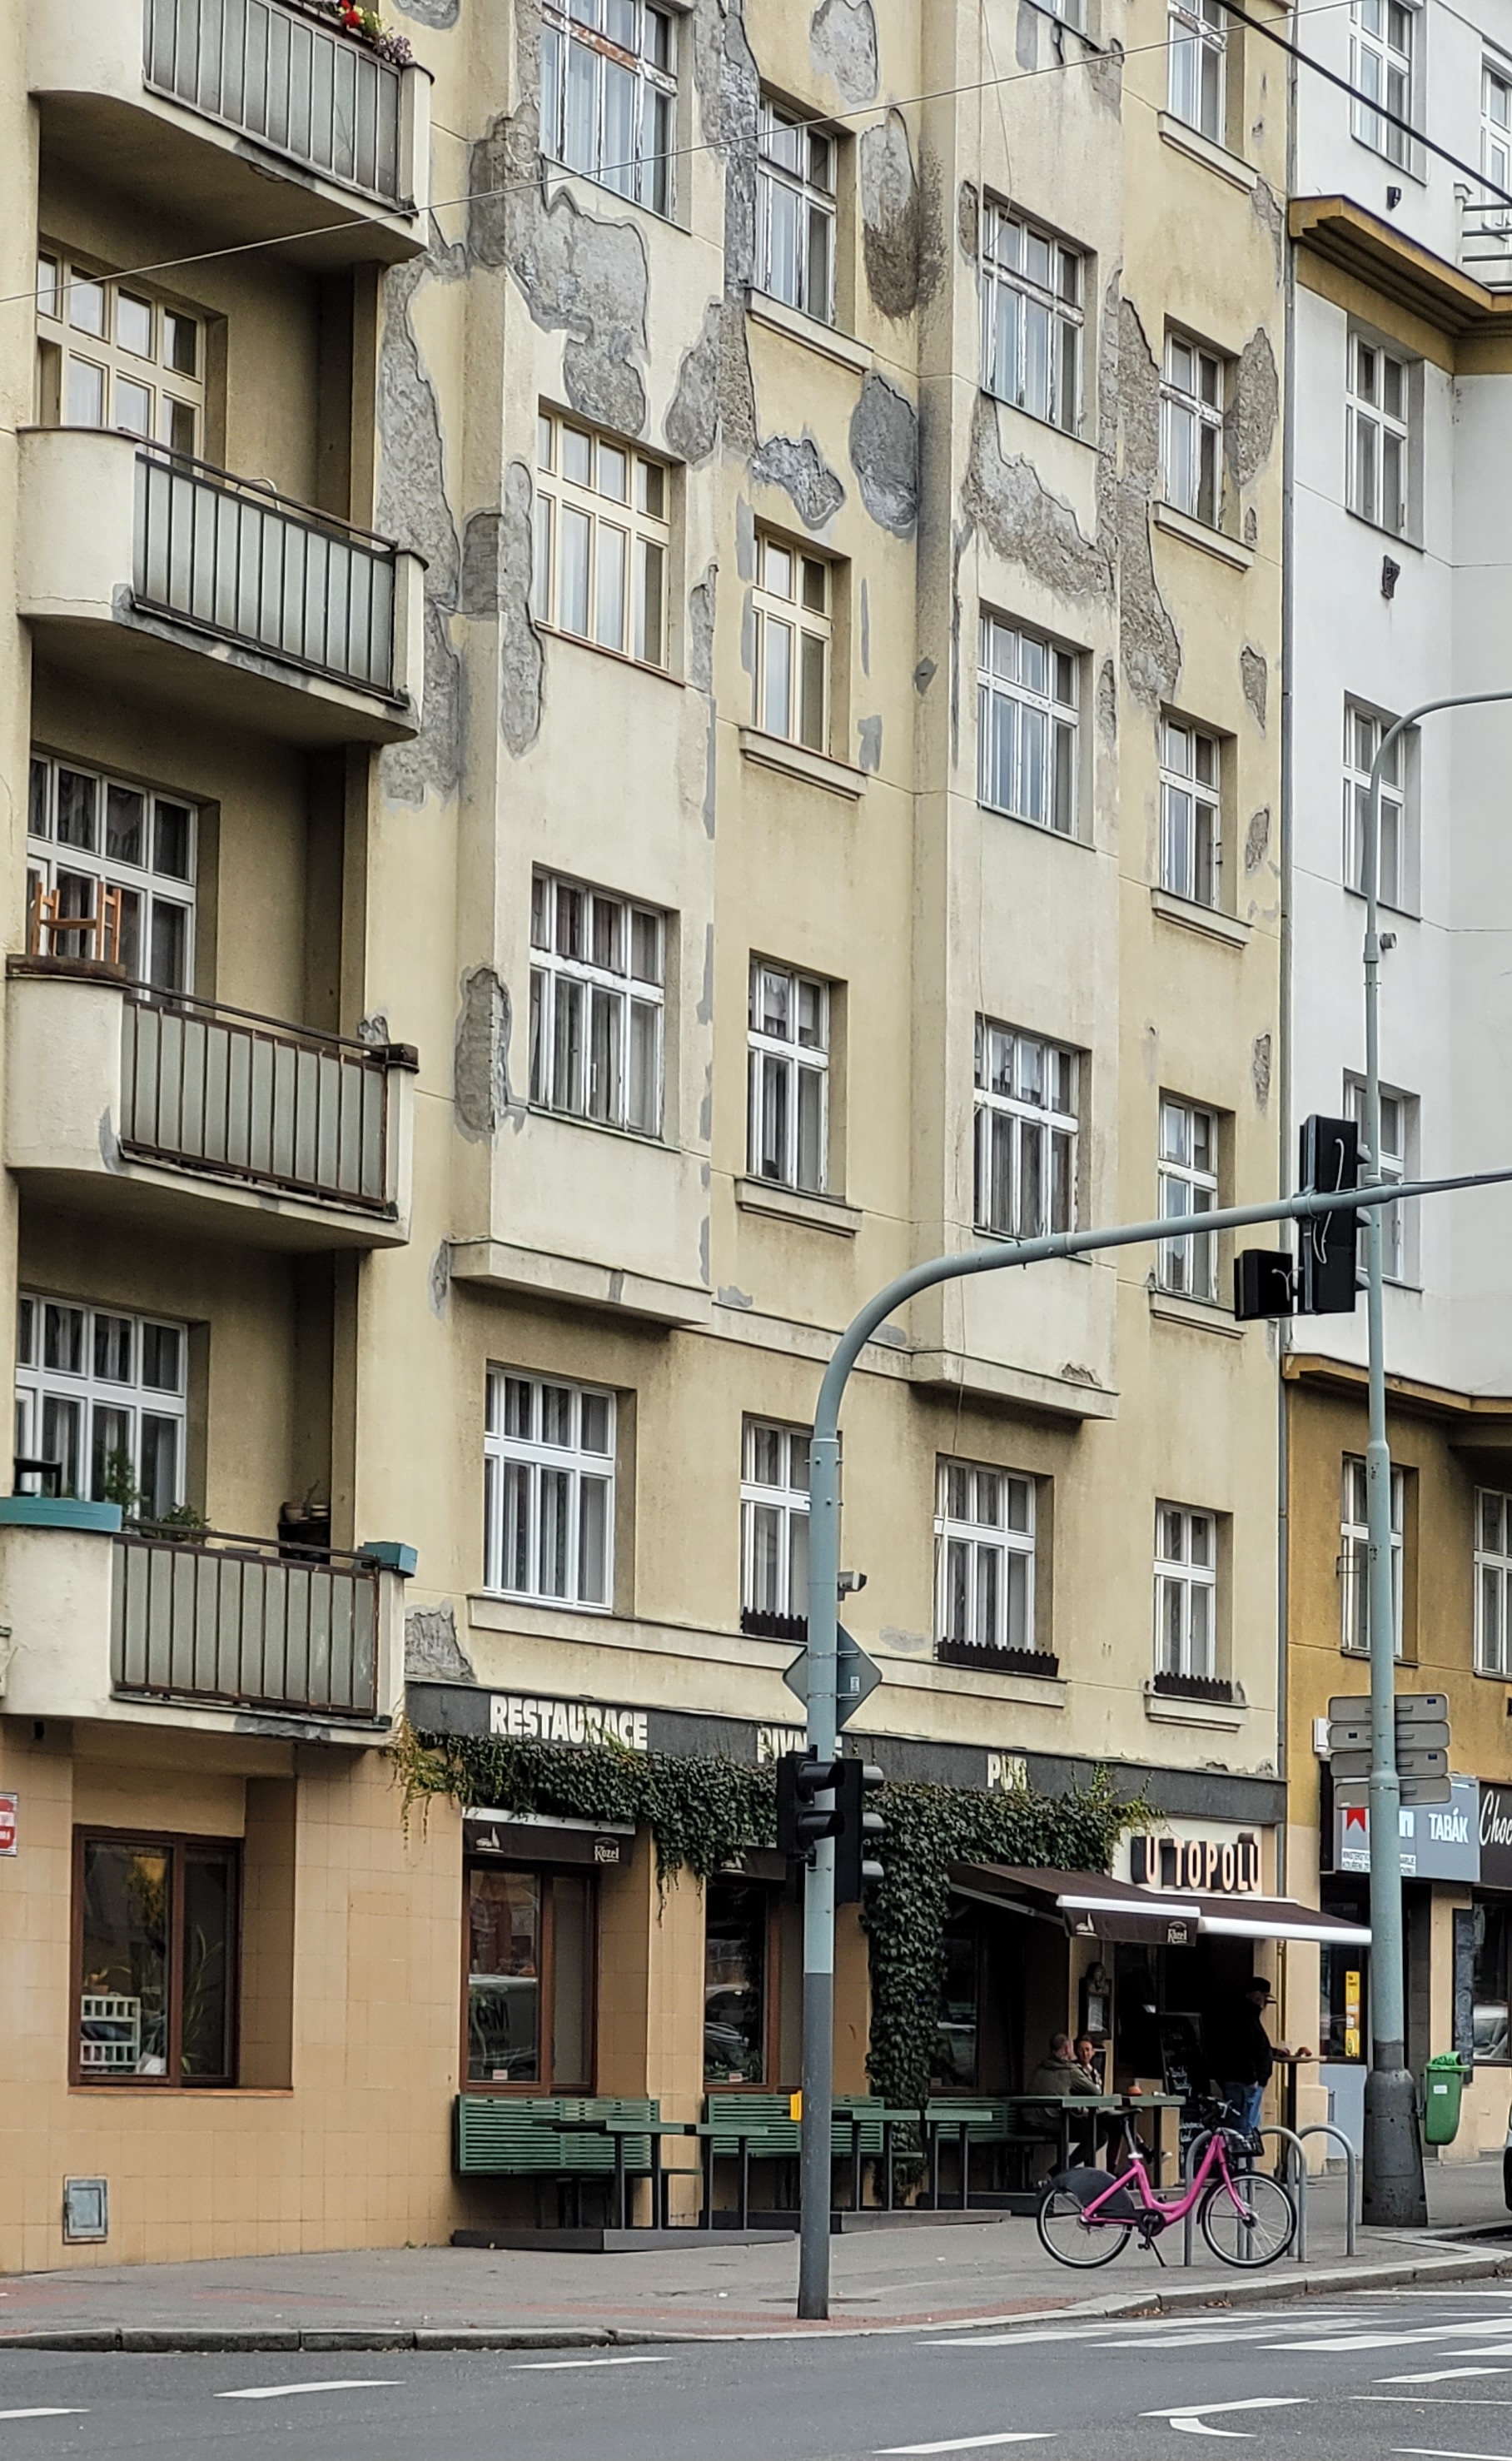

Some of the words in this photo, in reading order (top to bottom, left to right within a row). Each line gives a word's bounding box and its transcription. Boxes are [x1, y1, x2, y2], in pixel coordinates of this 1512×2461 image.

[490, 1695, 648, 1751] RESTAURACE
[987, 1754, 1027, 1791] PUB
[1428, 1807, 1469, 1844] TABÁK
[594, 1845, 619, 1863] Kozel
[1173, 1832, 1262, 1892] TOPOLŮ
